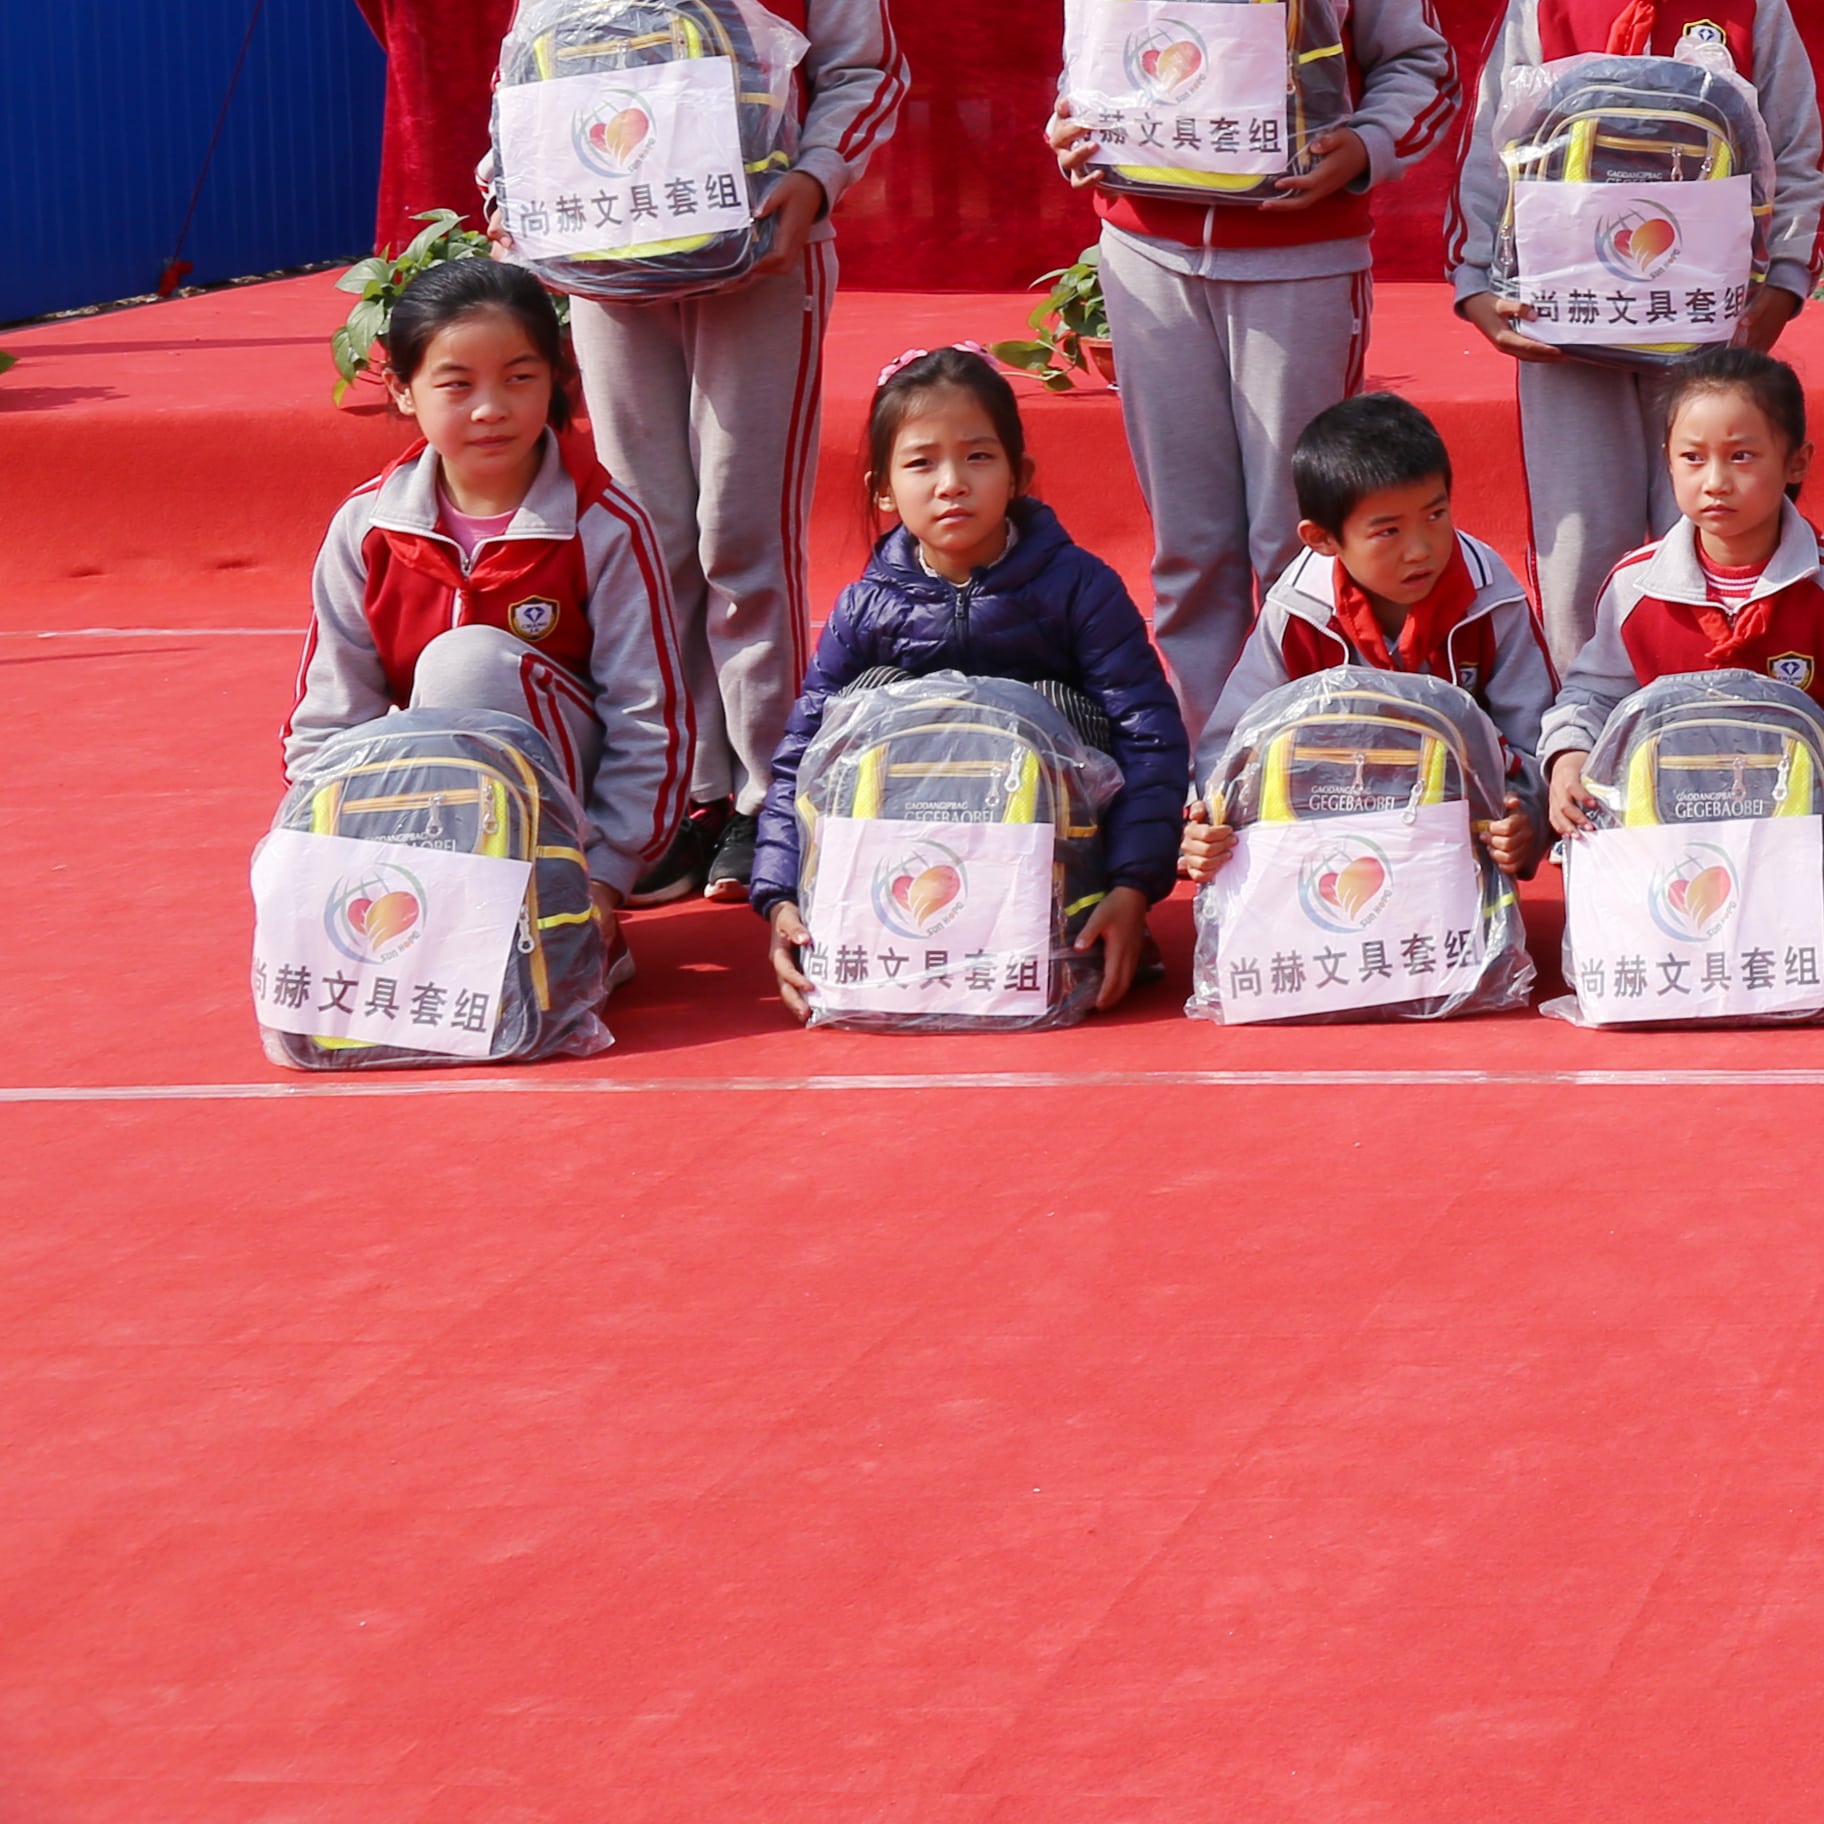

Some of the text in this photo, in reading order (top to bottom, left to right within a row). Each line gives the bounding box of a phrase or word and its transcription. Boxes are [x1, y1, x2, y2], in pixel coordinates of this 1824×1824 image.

[1078, 108, 1282, 154] 赫文具套组
[520, 172, 742, 238] 尚赫文具套组
[1309, 794, 1396, 812] GEGEBAOBEI
[1675, 799, 1764, 818] GEGEBAOBEI
[807, 941, 1041, 992] 尚赫文具套组
[1229, 929, 1481, 1000] 尚赫文具套组
[1581, 945, 1820, 999] 尚赫文具套组
[254, 956, 490, 1034] 尚赫文具套组
